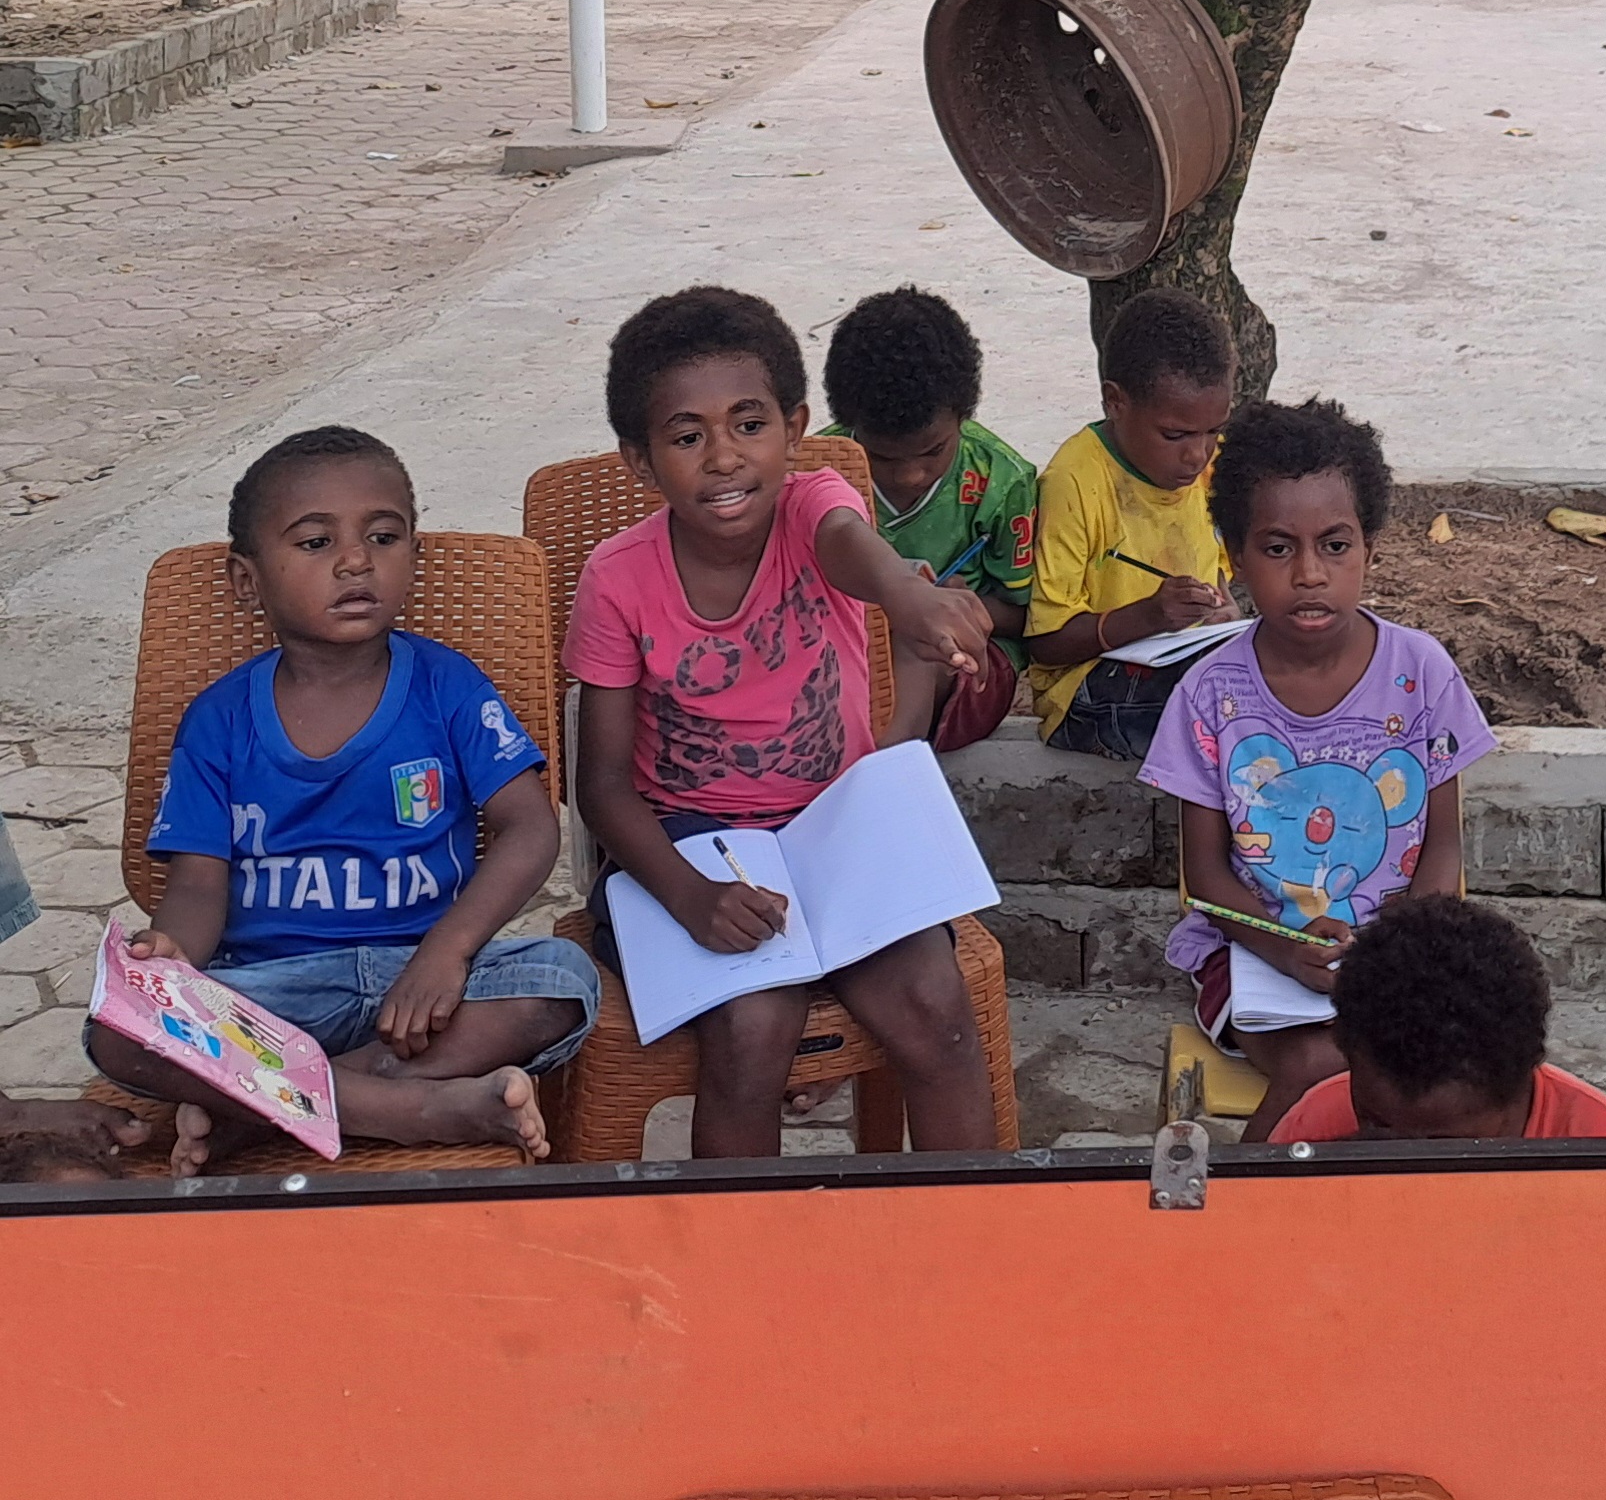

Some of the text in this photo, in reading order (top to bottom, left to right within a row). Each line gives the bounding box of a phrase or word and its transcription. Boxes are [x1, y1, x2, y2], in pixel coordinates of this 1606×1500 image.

[1010, 506, 1037, 569] 2
[394, 760, 437, 778] ITALIA
[239, 854, 440, 911] ITALIA
